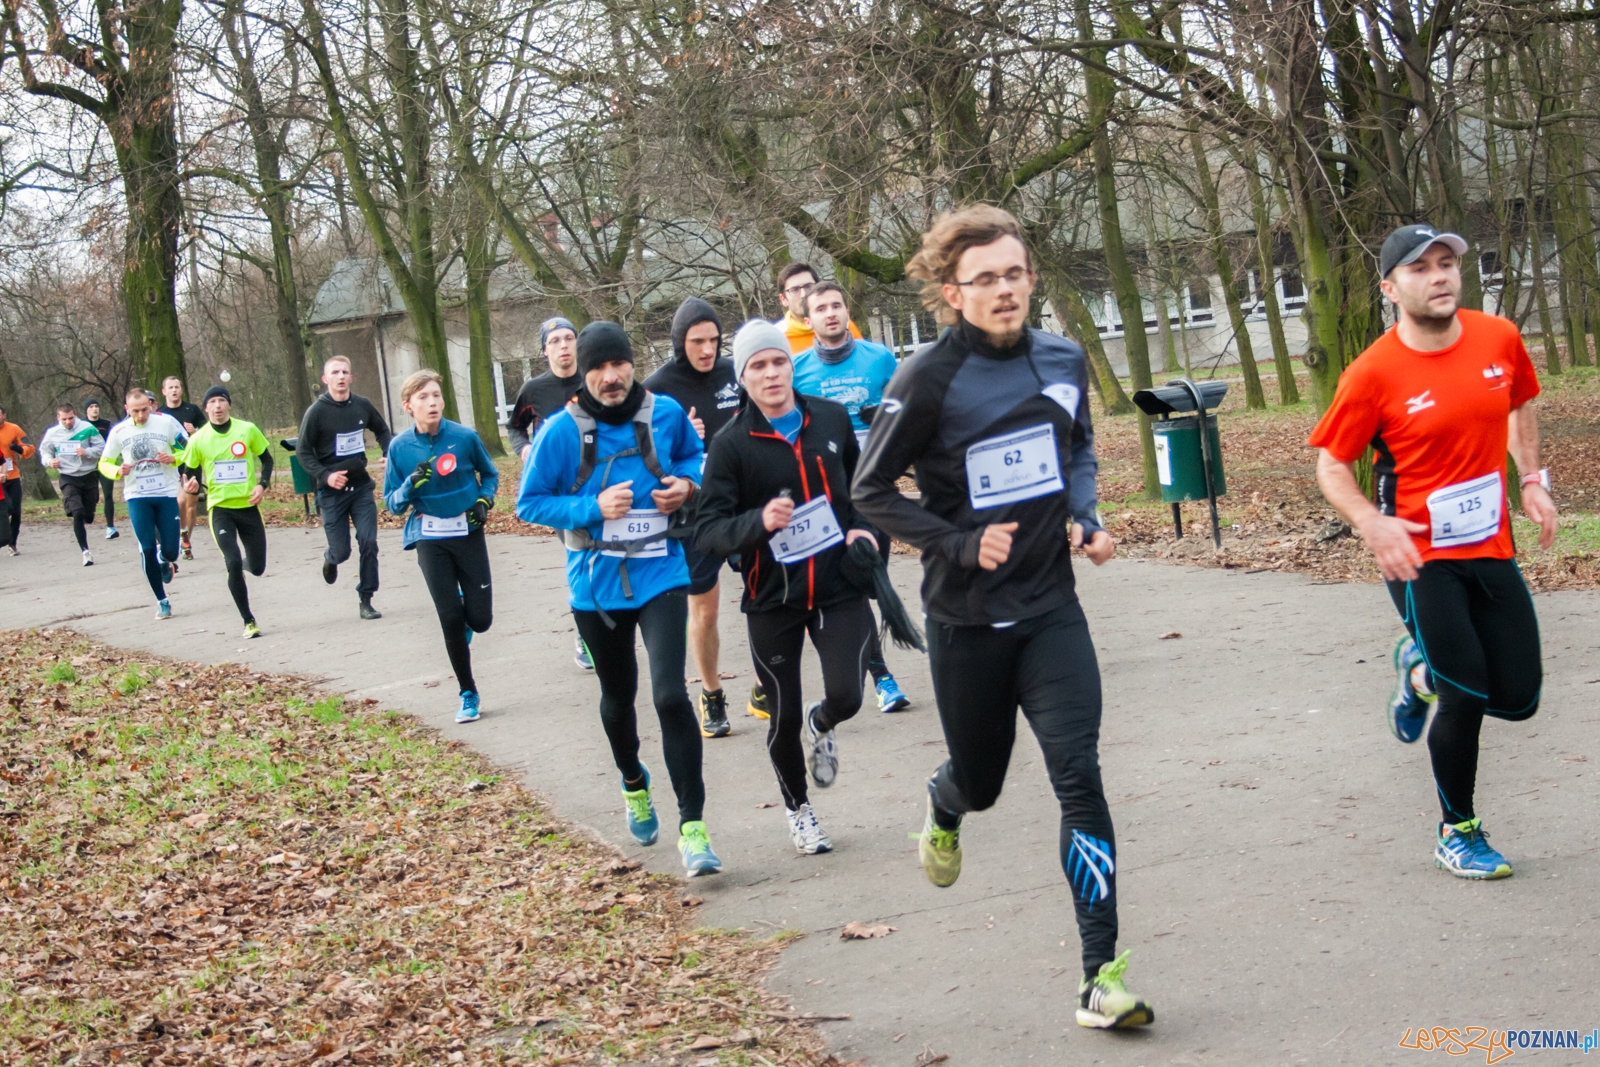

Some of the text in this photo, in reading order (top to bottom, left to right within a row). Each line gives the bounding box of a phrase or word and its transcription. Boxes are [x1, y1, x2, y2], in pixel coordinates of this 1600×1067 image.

[1003, 449, 1023, 466] 62
[1458, 496, 1482, 515] 125
[627, 522, 650, 533] 619
[788, 518, 810, 536] 757
